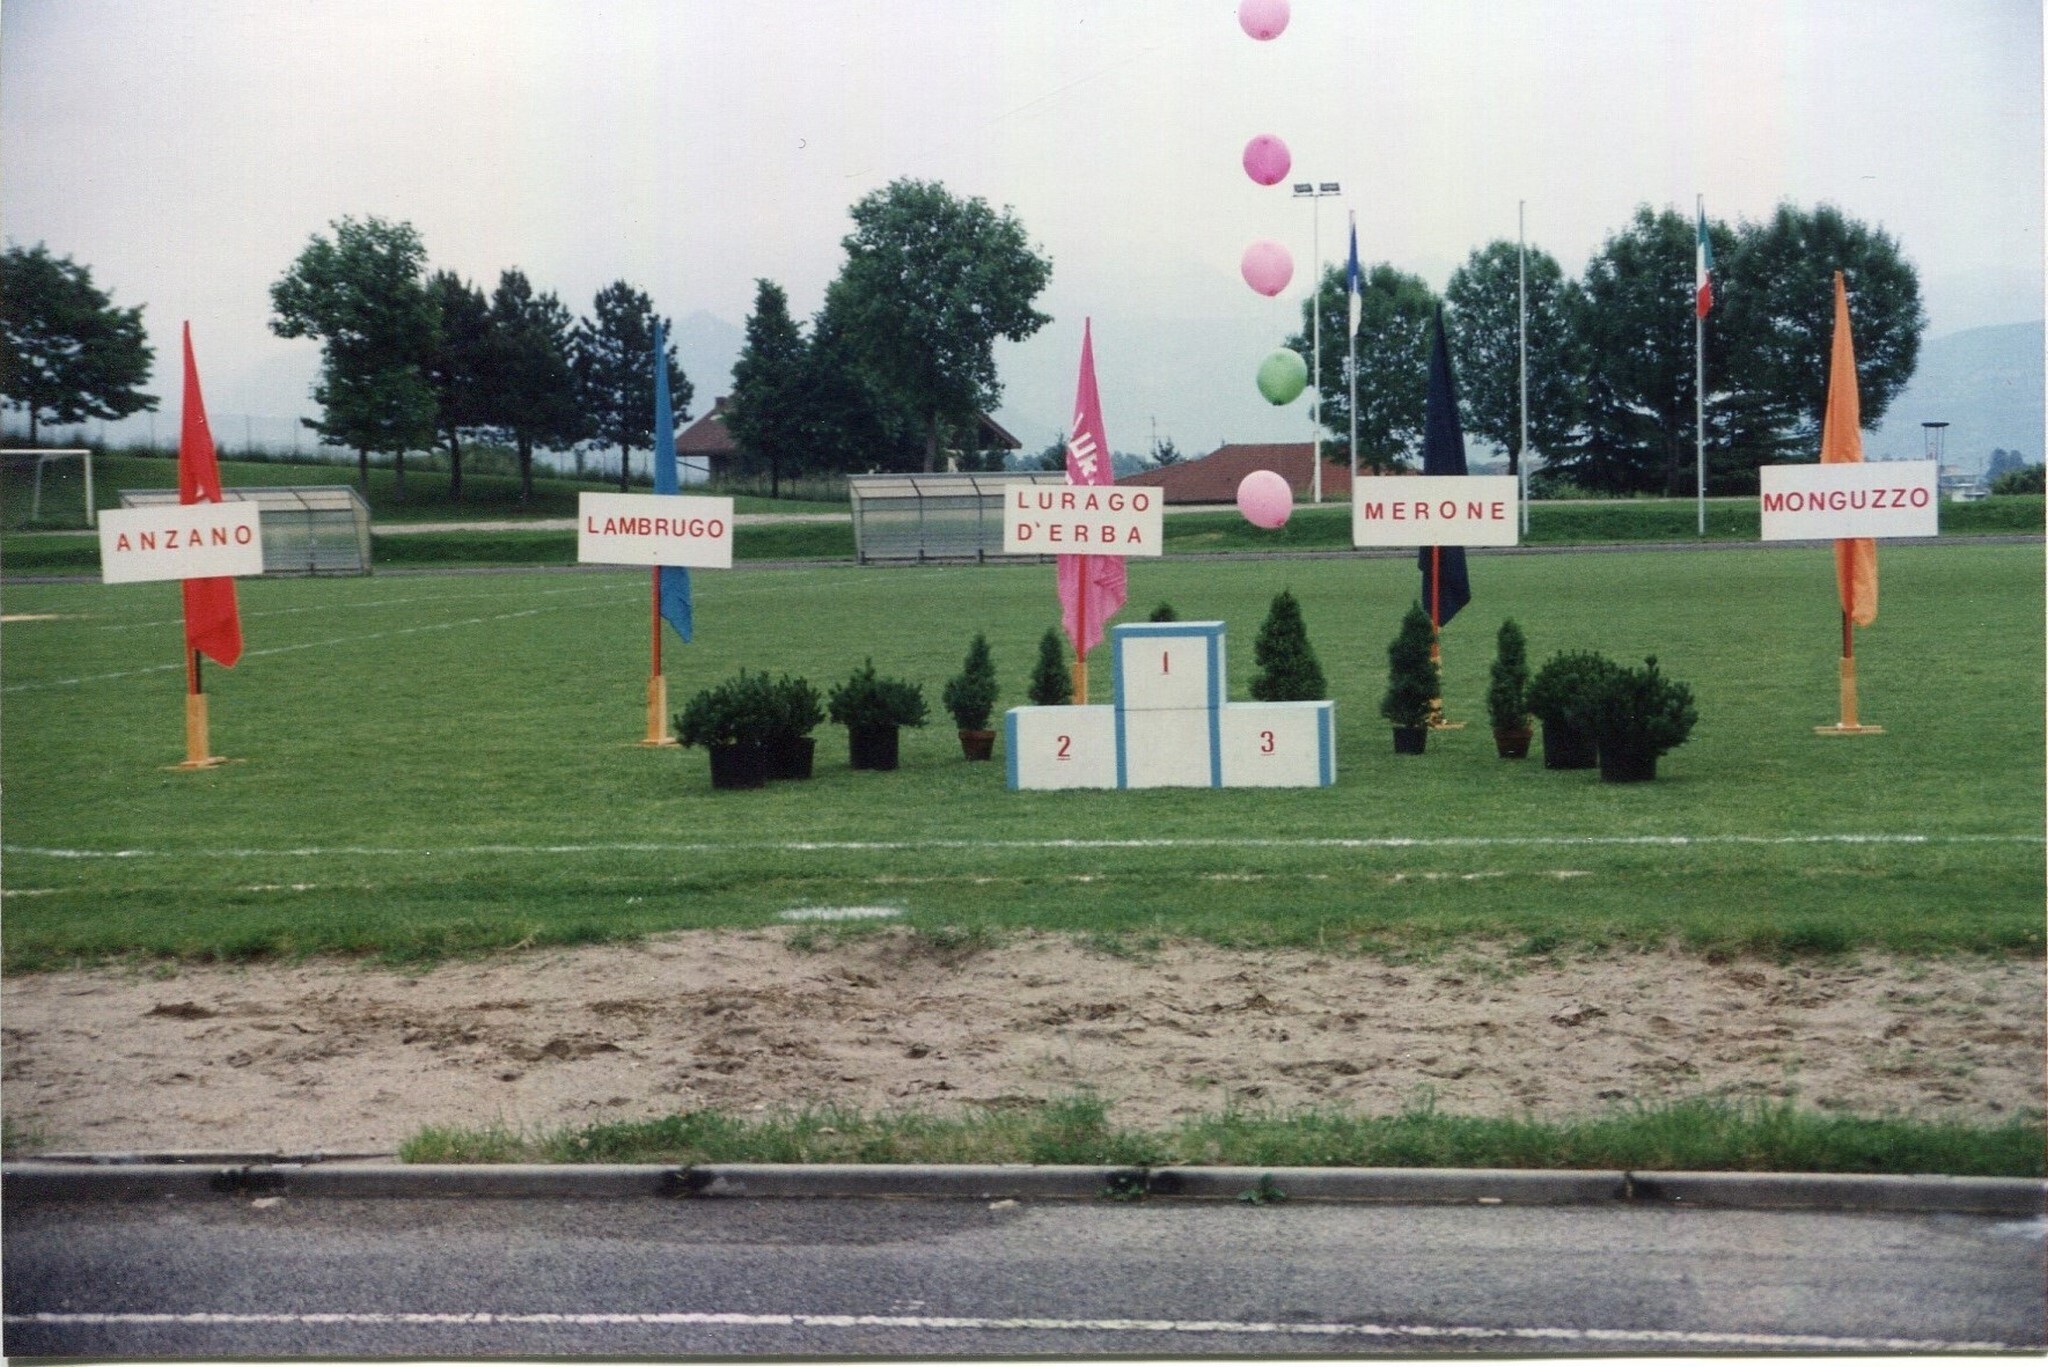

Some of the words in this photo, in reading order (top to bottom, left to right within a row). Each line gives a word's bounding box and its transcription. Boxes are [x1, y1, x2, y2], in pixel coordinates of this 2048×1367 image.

[1018, 491, 1149, 512] LURAGO
[1364, 501, 1505, 521] MERONE
[1761, 487, 1929, 513] MONGUZZO
[117, 524, 253, 551] ANZANO
[587, 516, 725, 539] LAMBRUGO
[1017, 522, 1142, 544] D'ERBA
[1057, 735, 1071, 760] 2
[1260, 730, 1274, 755] 3
